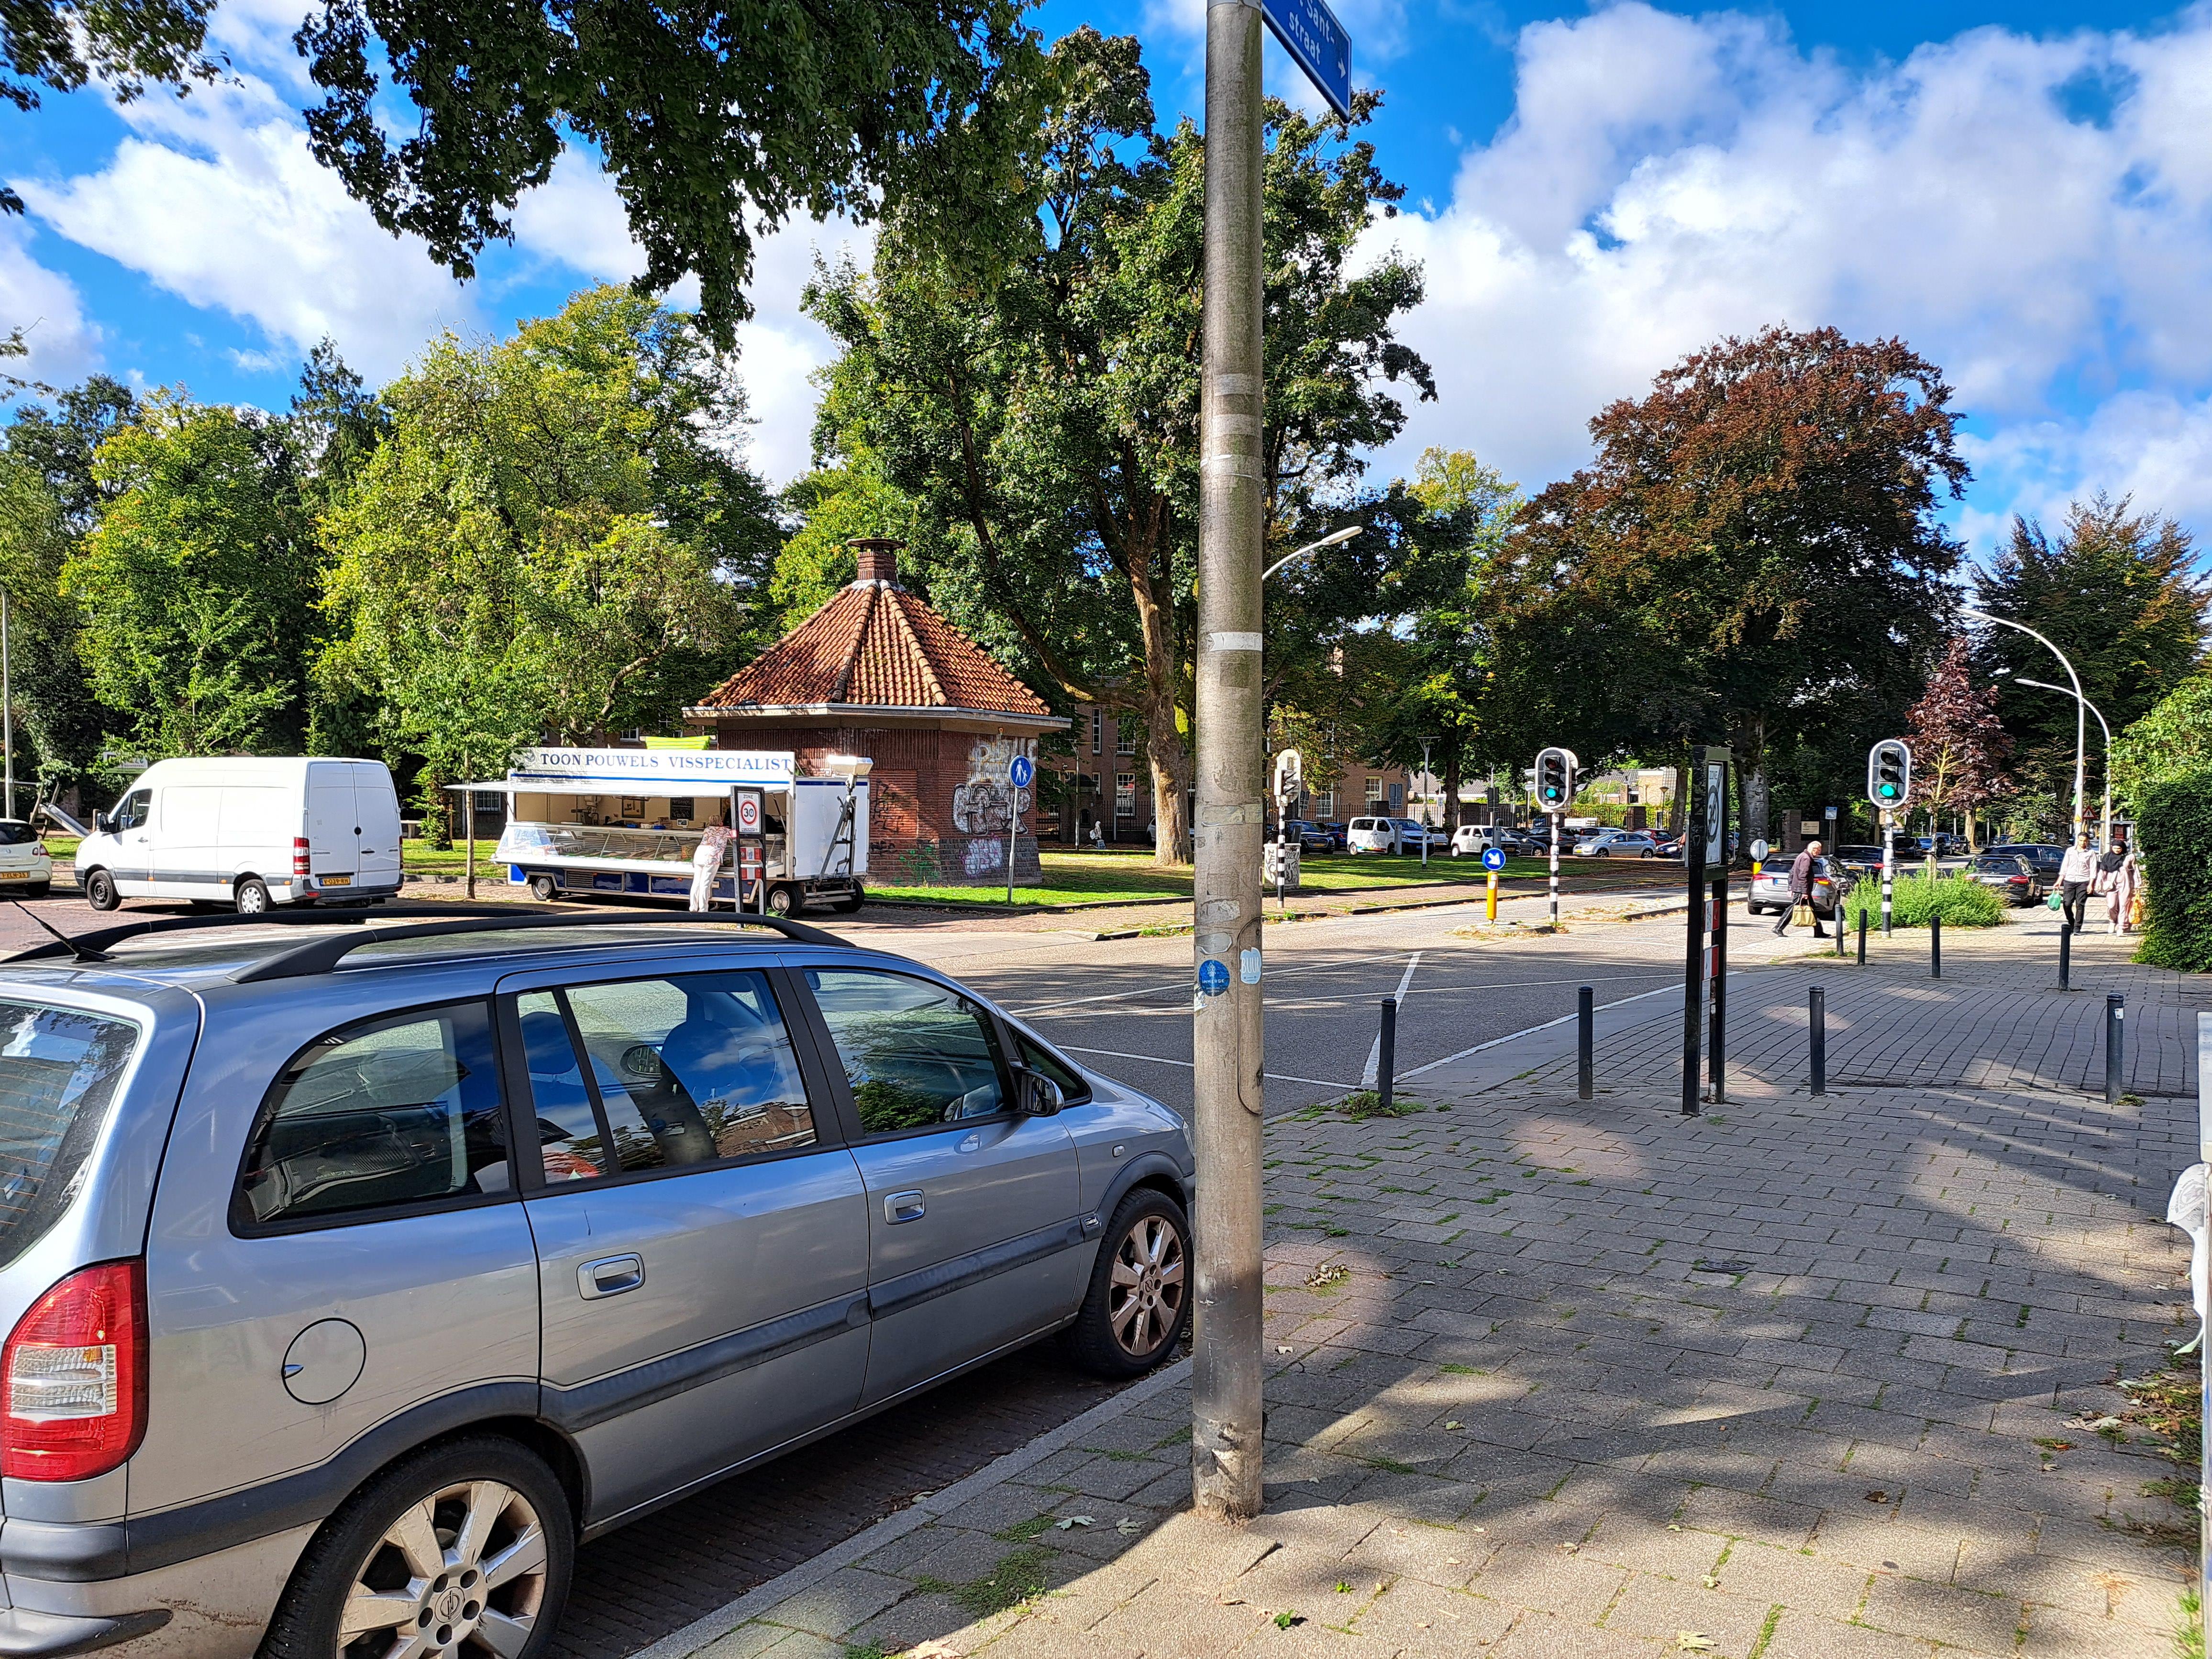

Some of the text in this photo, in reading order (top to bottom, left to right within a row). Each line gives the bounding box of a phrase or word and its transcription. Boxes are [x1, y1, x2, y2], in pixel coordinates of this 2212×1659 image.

[1289, 11, 1320, 66] straat
[541, 753, 792, 771] TOON POUWELS VISSPECIALIST
[744, 808, 754, 818] 30
